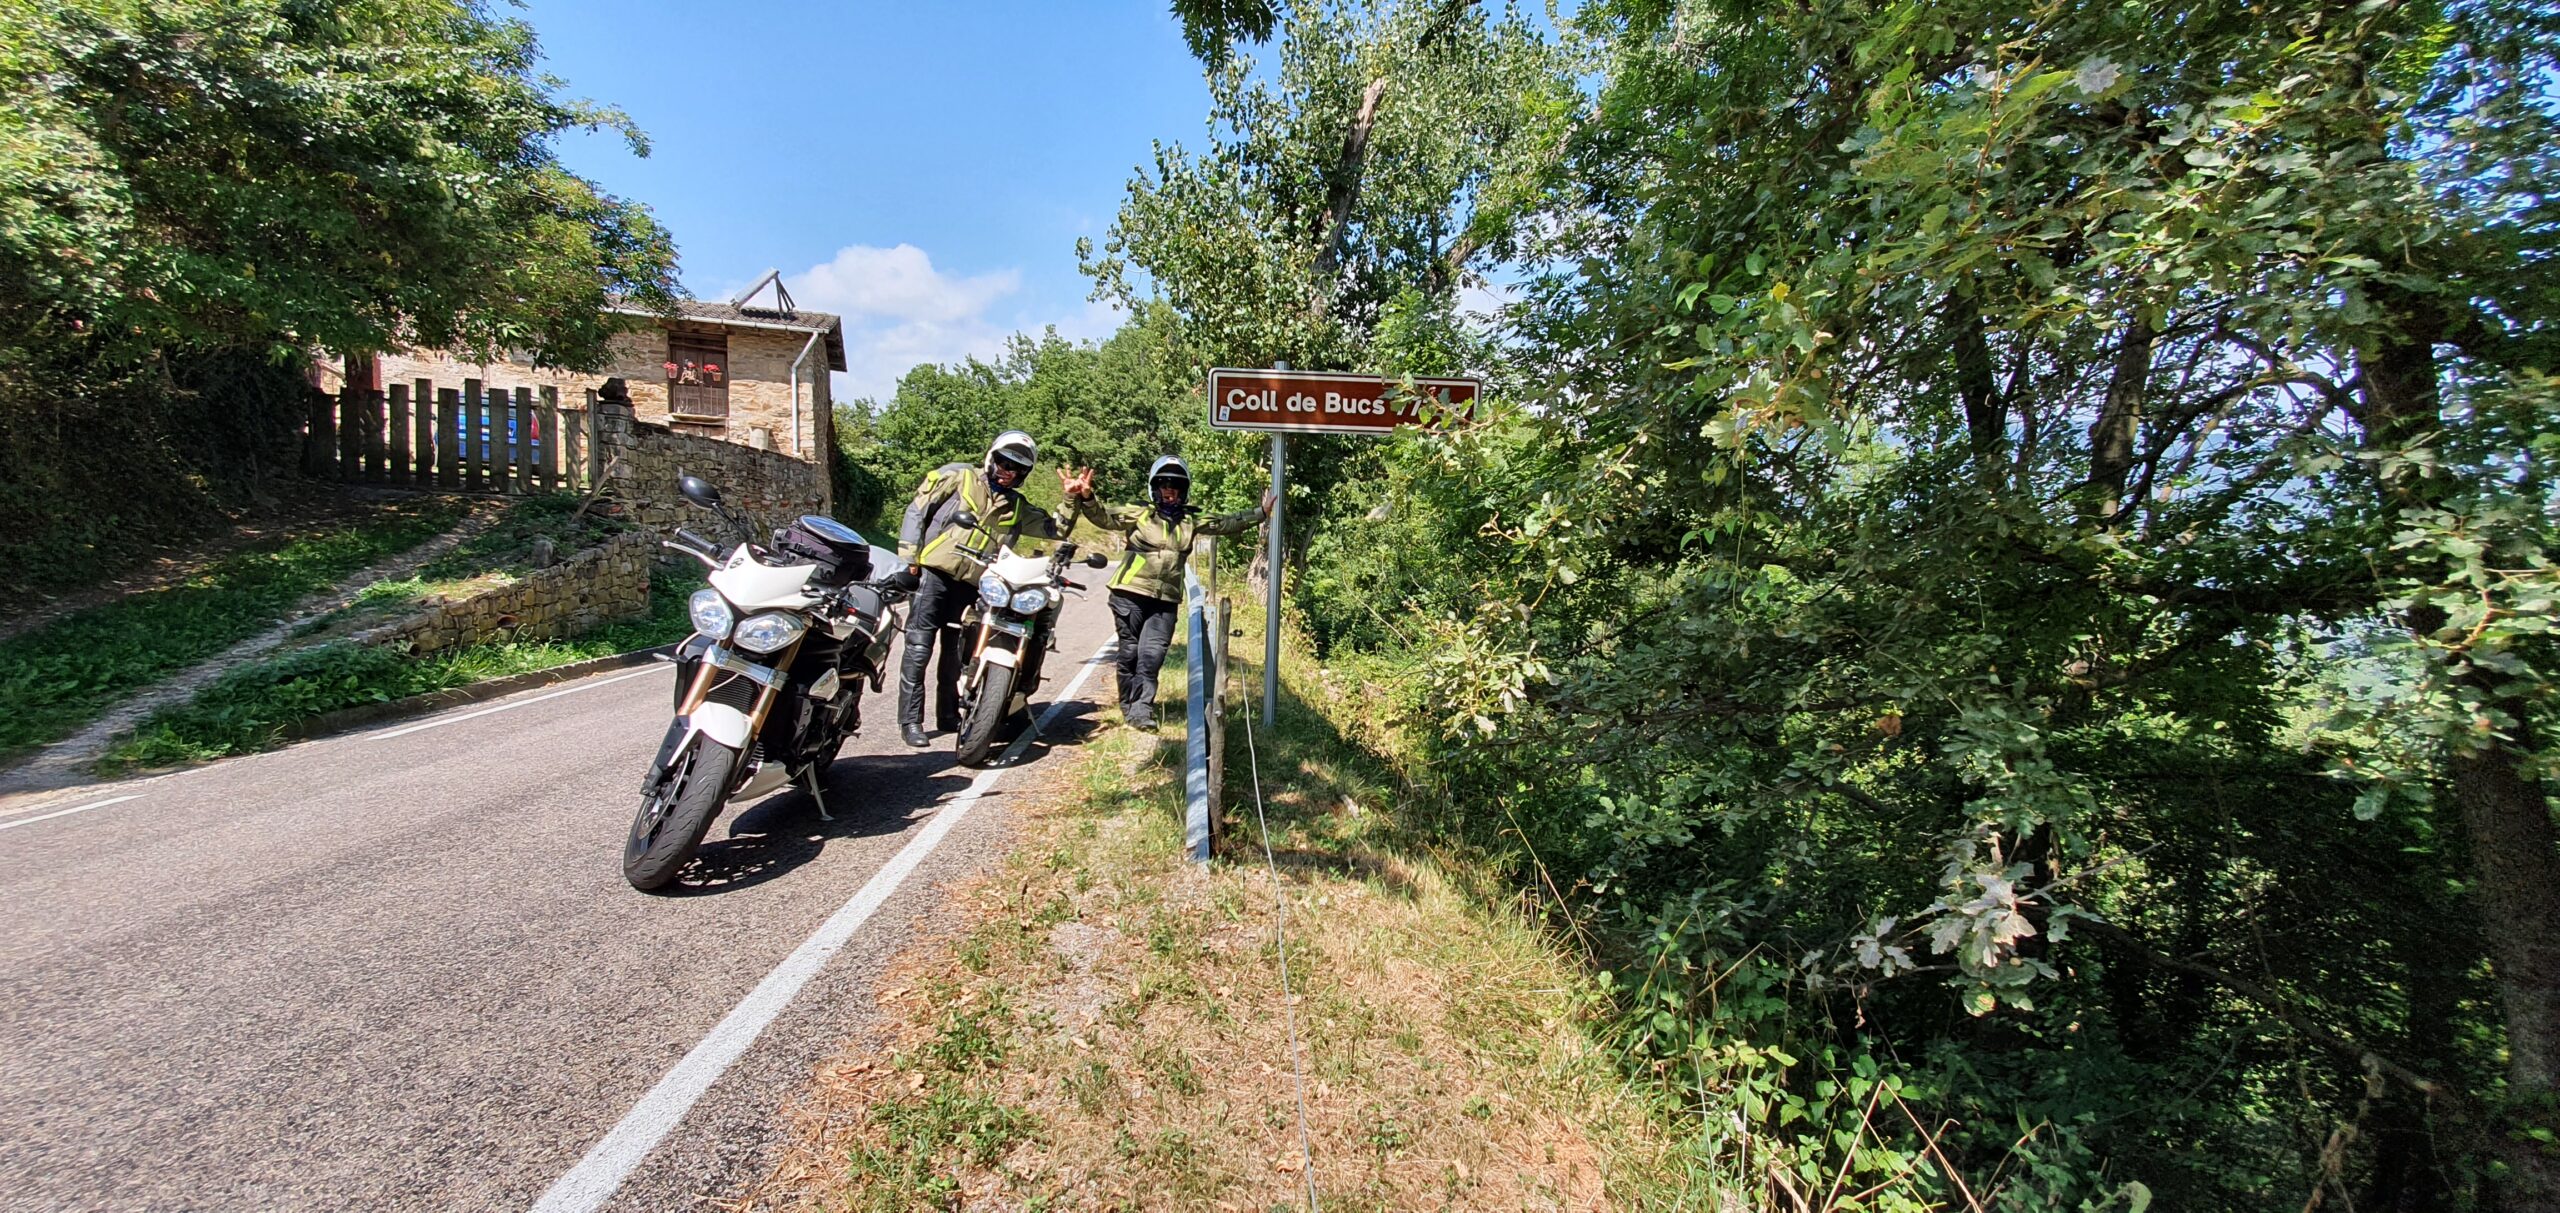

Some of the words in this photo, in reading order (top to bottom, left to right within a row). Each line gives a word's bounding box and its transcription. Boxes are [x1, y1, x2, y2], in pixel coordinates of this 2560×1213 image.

[1227, 389, 1278, 411] Coll
[1286, 392, 1317, 412] de
[1325, 392, 1386, 415] Bucs
